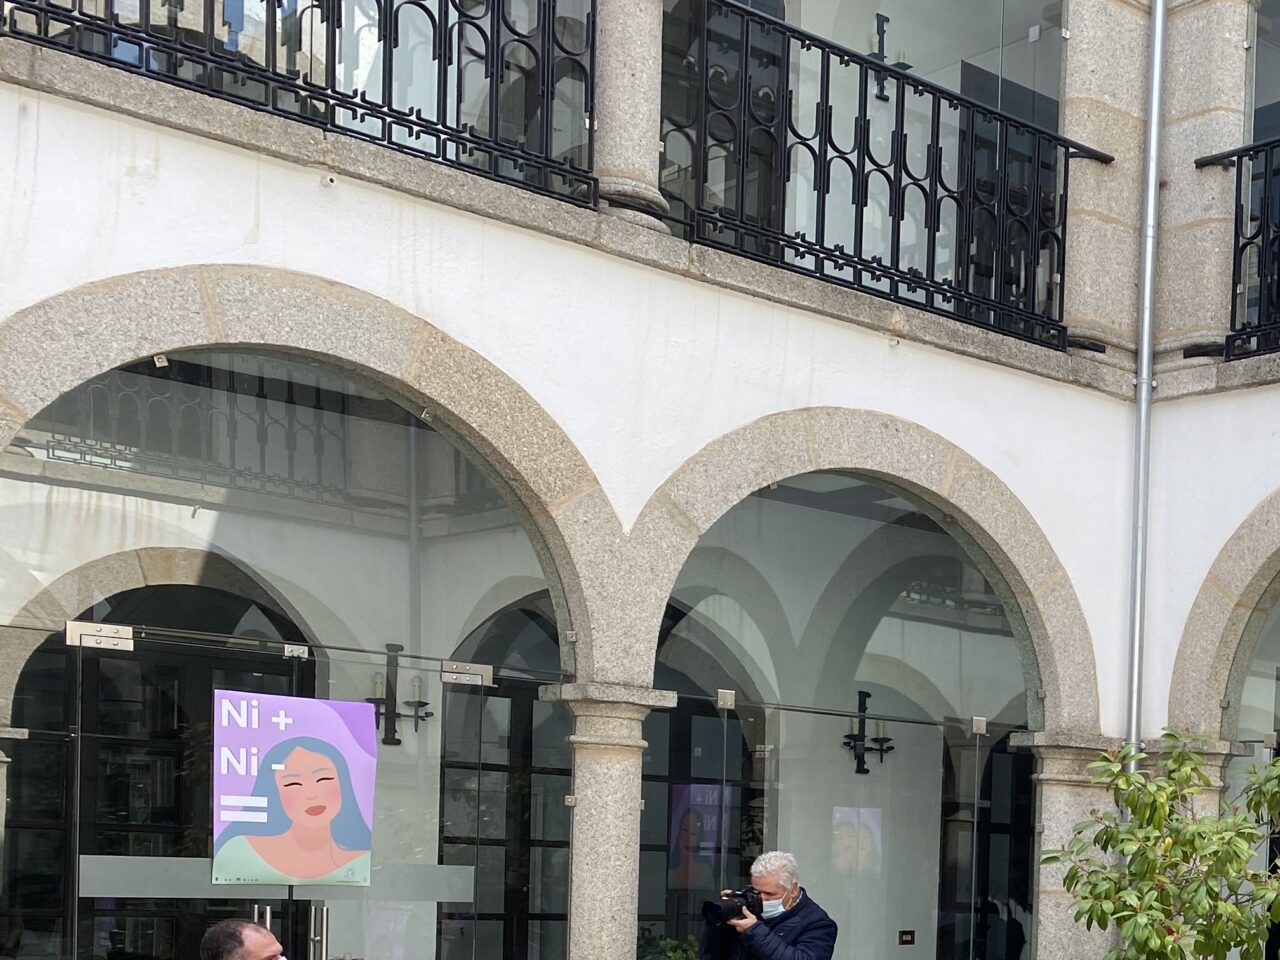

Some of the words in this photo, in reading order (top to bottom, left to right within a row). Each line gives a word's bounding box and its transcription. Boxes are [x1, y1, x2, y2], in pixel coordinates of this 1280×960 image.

[220, 698, 260, 729] Ni
[271, 709, 294, 731] +
[220, 746, 259, 777] Ni
